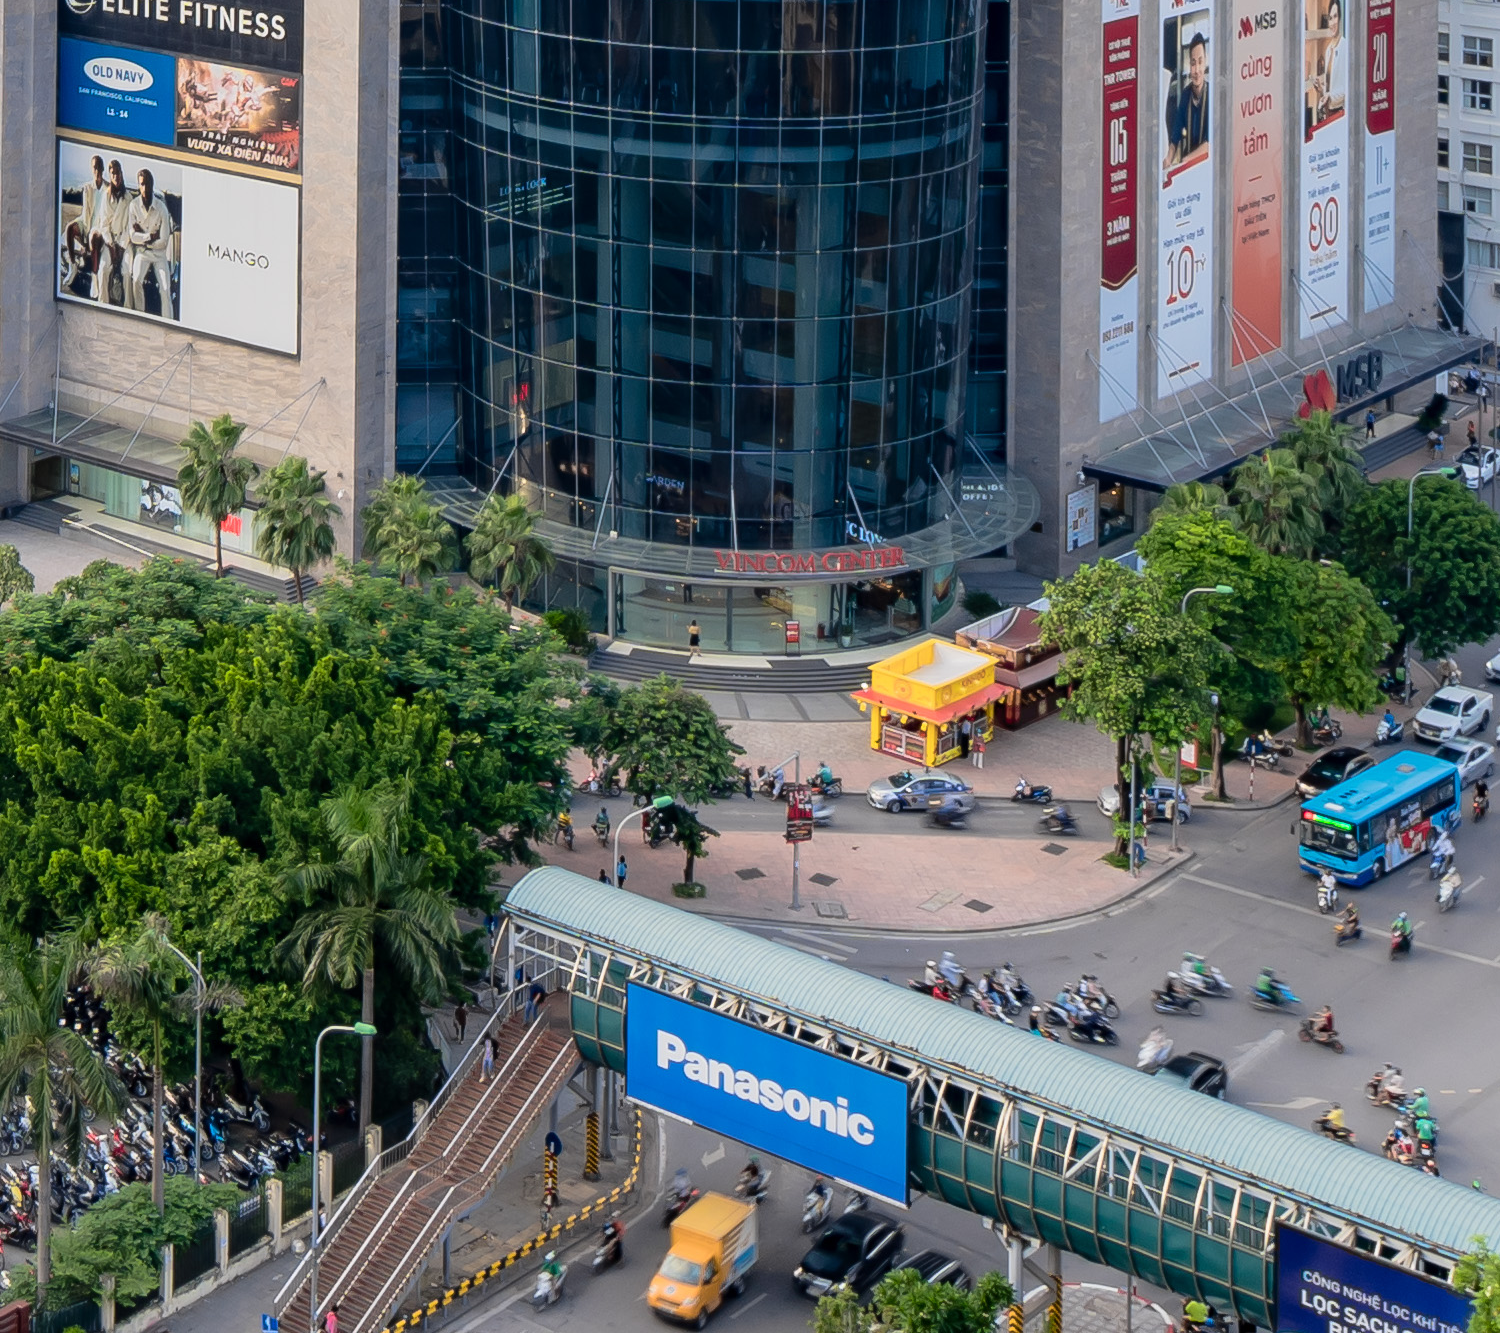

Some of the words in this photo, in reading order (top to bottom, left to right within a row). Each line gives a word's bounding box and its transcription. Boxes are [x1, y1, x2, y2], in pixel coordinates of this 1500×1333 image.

[180, 0, 286, 40] FITNESS
[1255, 11, 1277, 32] MSB
[1241, 55, 1272, 80] cùng
[1373, 32, 1387, 83] 20
[92, 64, 113, 79] OLD
[116, 67, 144, 85] NAVY
[1240, 93, 1272, 118] vươn
[217, 144, 231, 156] XA
[1110, 116, 1127, 166] 05
[1309, 196, 1338, 251] 80
[208, 243, 270, 269] MANGO
[1166, 246, 1194, 305] 10
[1337, 349, 1383, 403] MSB
[714, 550, 816, 572] VINCOM
[822, 547, 906, 572] CENTER
[657, 1029, 874, 1146] Panasonic
[1301, 1289, 1340, 1316] LỌC
[1303, 1270, 1341, 1293] CÔNG
[1343, 1286, 1381, 1311] NGHỆ
[1383, 1301, 1409, 1319] LỌC
[1413, 1312, 1437, 1330] KHÍ
